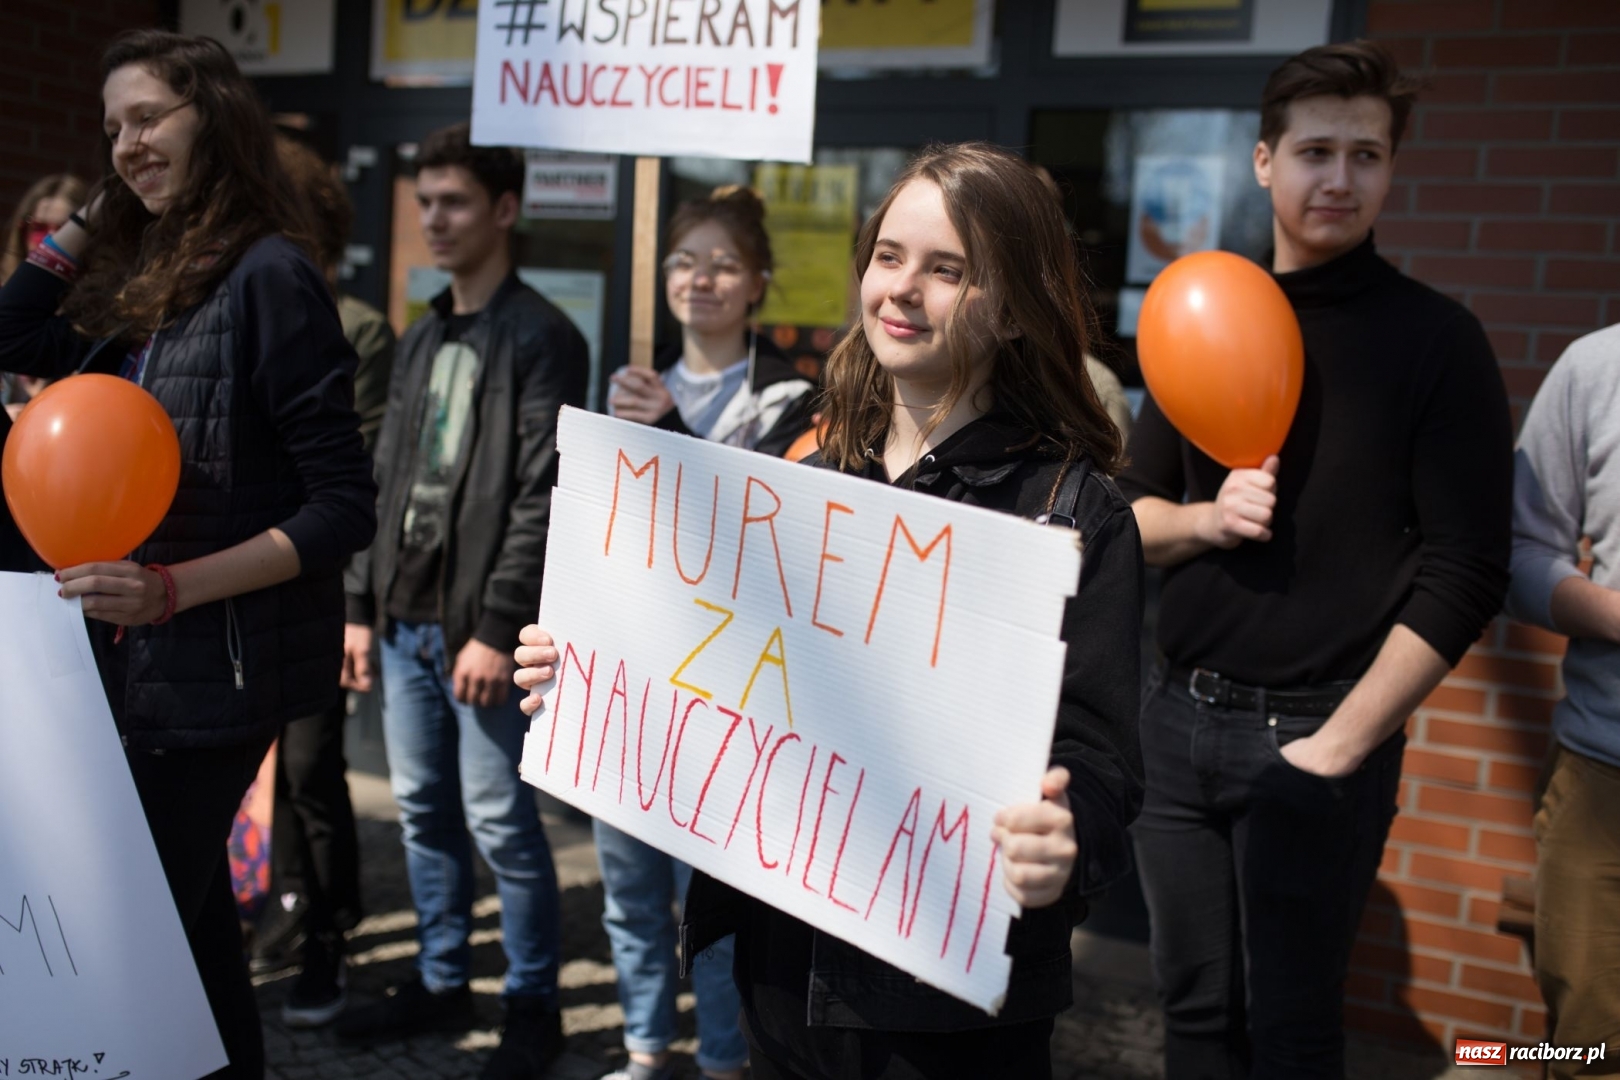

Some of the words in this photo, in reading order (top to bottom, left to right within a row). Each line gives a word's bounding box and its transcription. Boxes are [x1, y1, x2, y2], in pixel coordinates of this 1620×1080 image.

[494, 0, 799, 48] #WSPIERAM
[500, 60, 784, 115] NAUCZYCIELI!
[605, 448, 953, 668] MUREM
[669, 599, 794, 728] ZA
[545, 642, 1000, 974] NAUCZYCIELAMI
